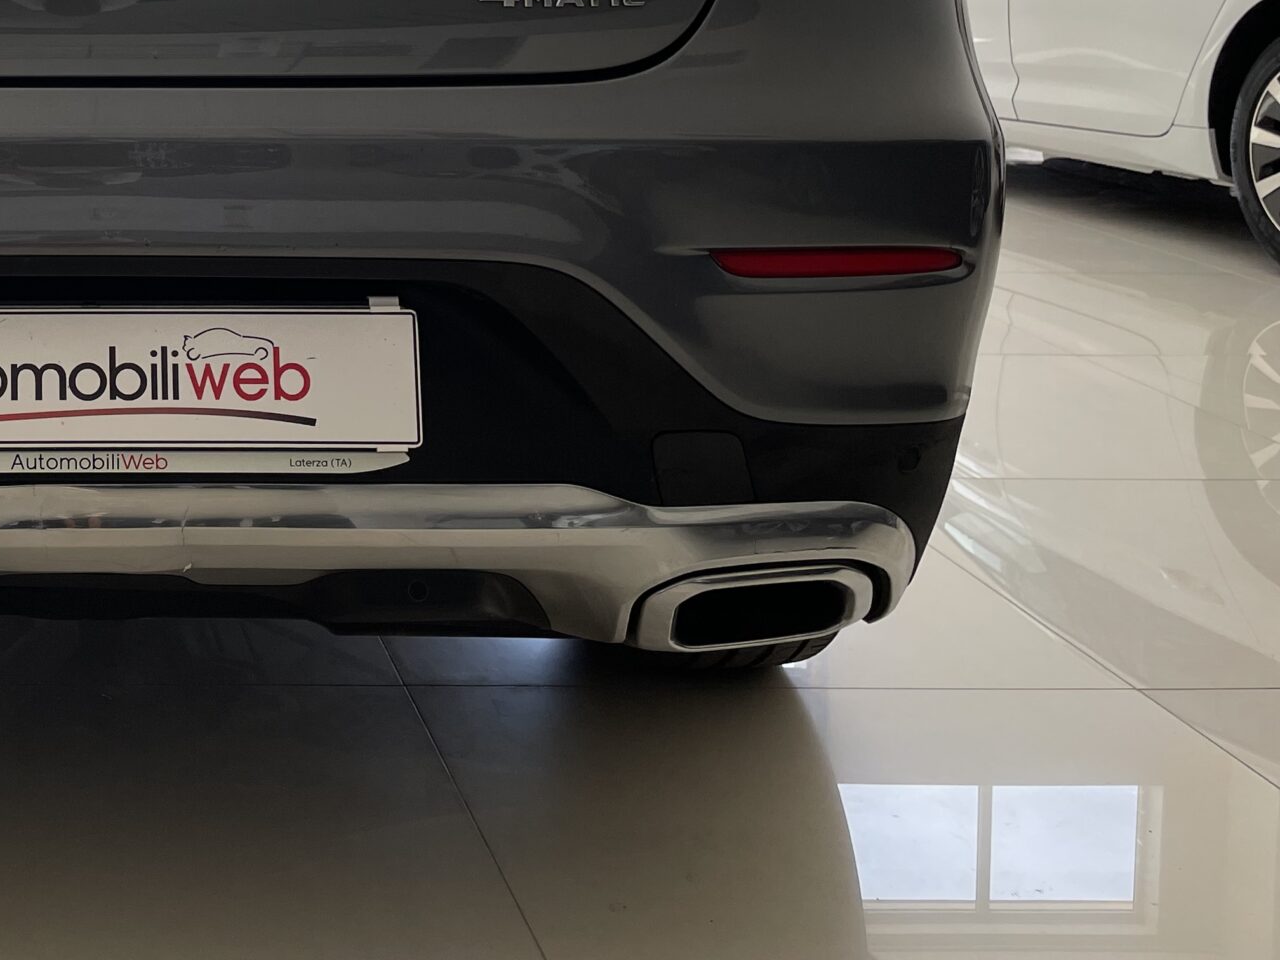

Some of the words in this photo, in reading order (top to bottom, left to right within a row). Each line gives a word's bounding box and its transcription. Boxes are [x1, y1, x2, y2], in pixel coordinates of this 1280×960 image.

[10, 453, 169, 471] AutomobiliWeb
[289, 458, 329, 468] Laterza
[330, 458, 352, 469] (TA)
